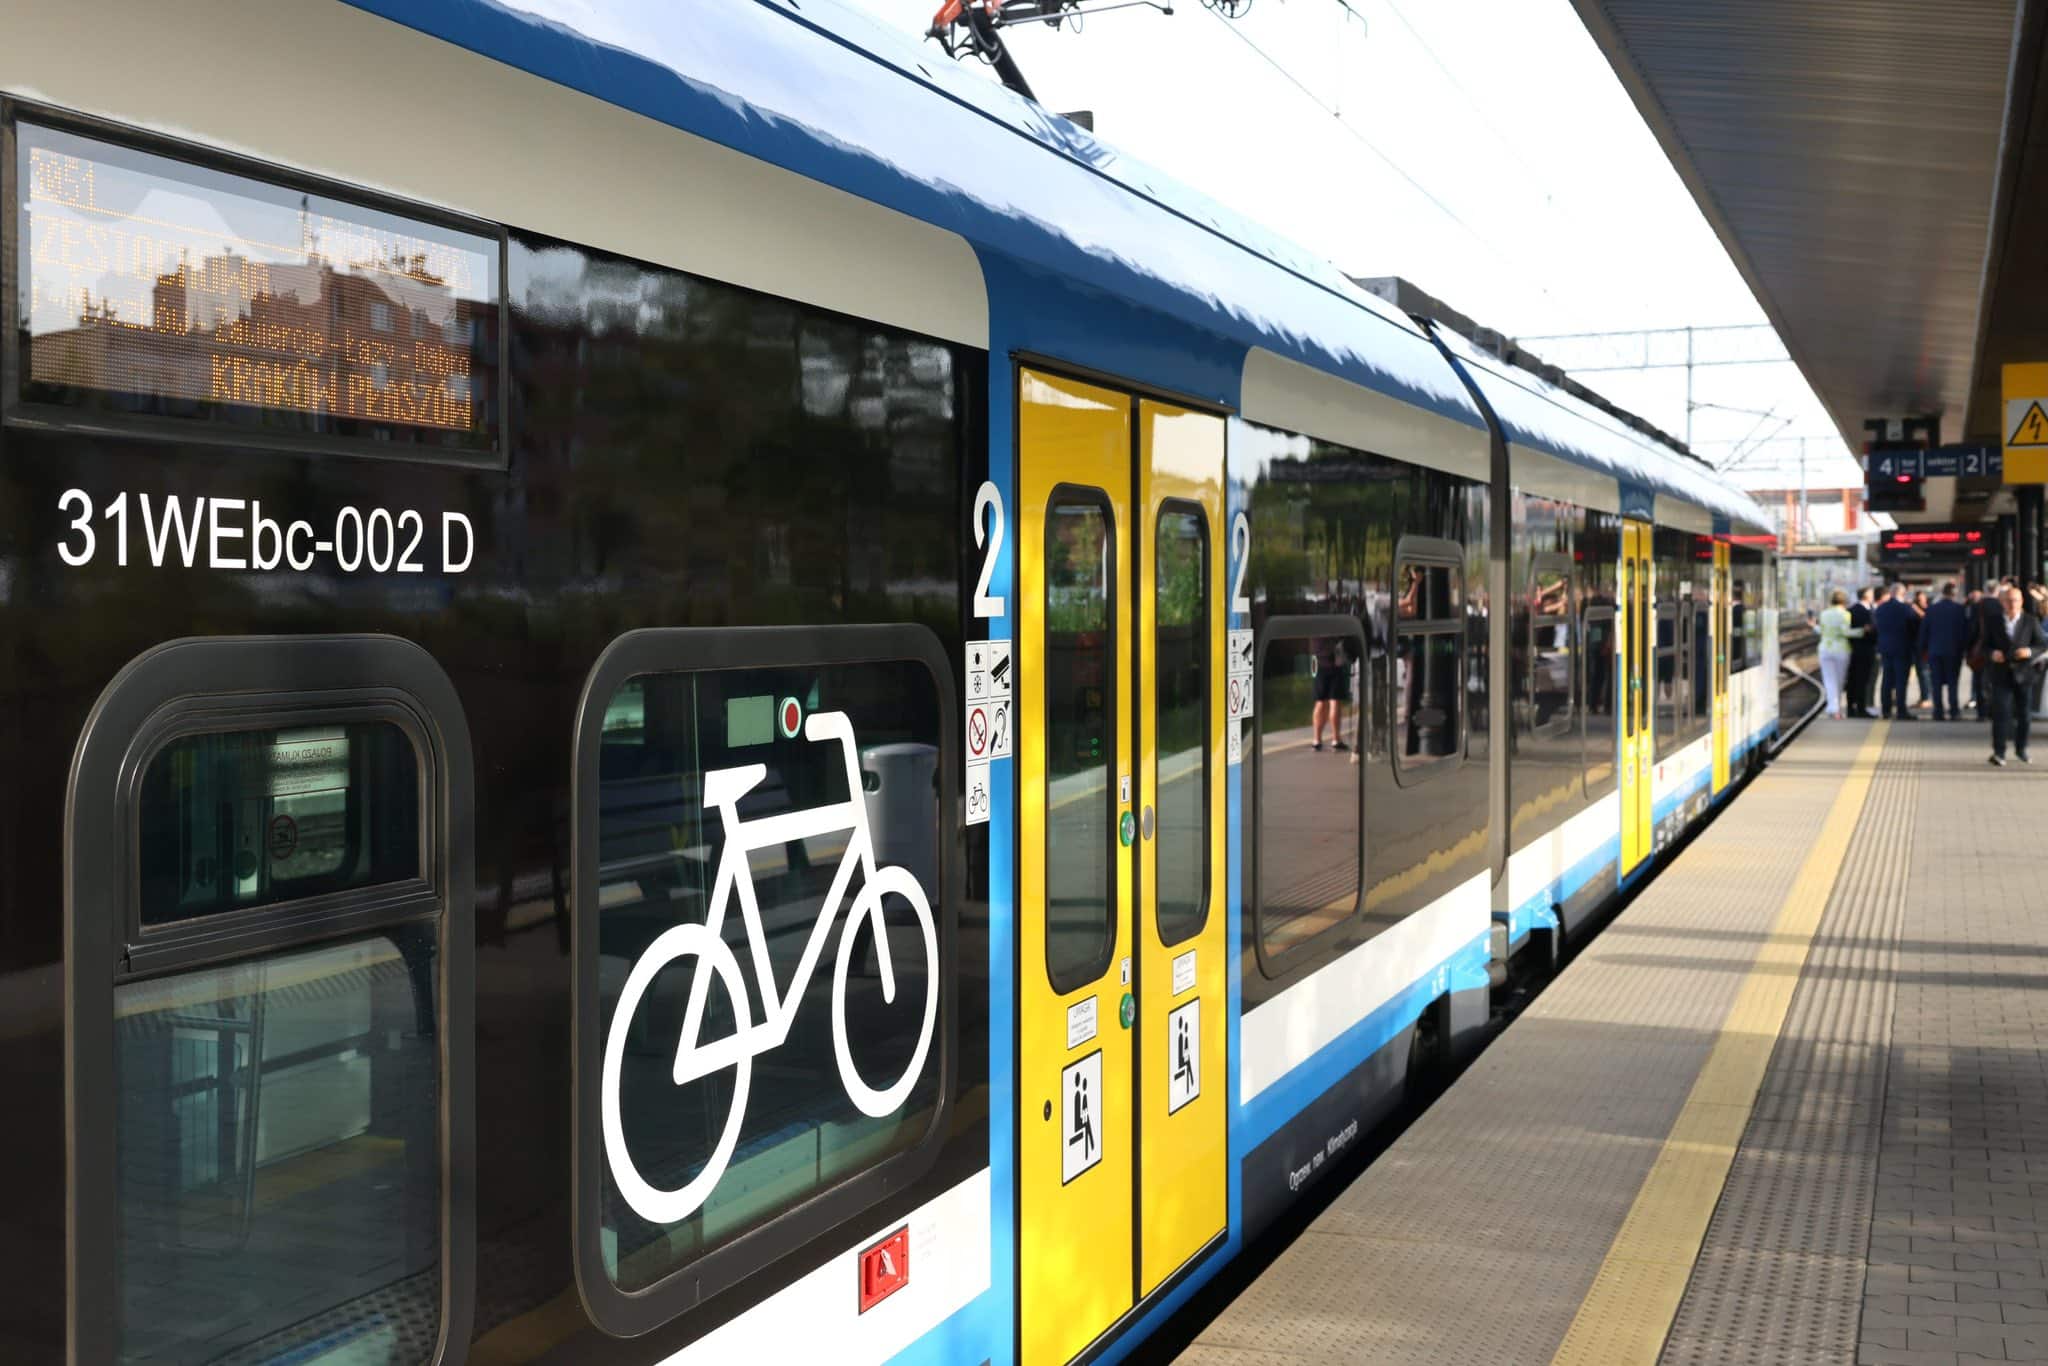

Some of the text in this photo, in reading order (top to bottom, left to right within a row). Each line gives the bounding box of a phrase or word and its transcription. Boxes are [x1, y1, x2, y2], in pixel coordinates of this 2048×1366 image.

[214, 305, 323, 358] Zawiercie
[211, 347, 471, 428] KRAKÓW PŁASZÓW
[1879, 458, 1892, 475] 4
[1966, 454, 1979, 473] 2
[57, 488, 474, 573] 31WEbc-002 D
[973, 480, 1005, 618] 2
[1232, 511, 1251, 614] 2
